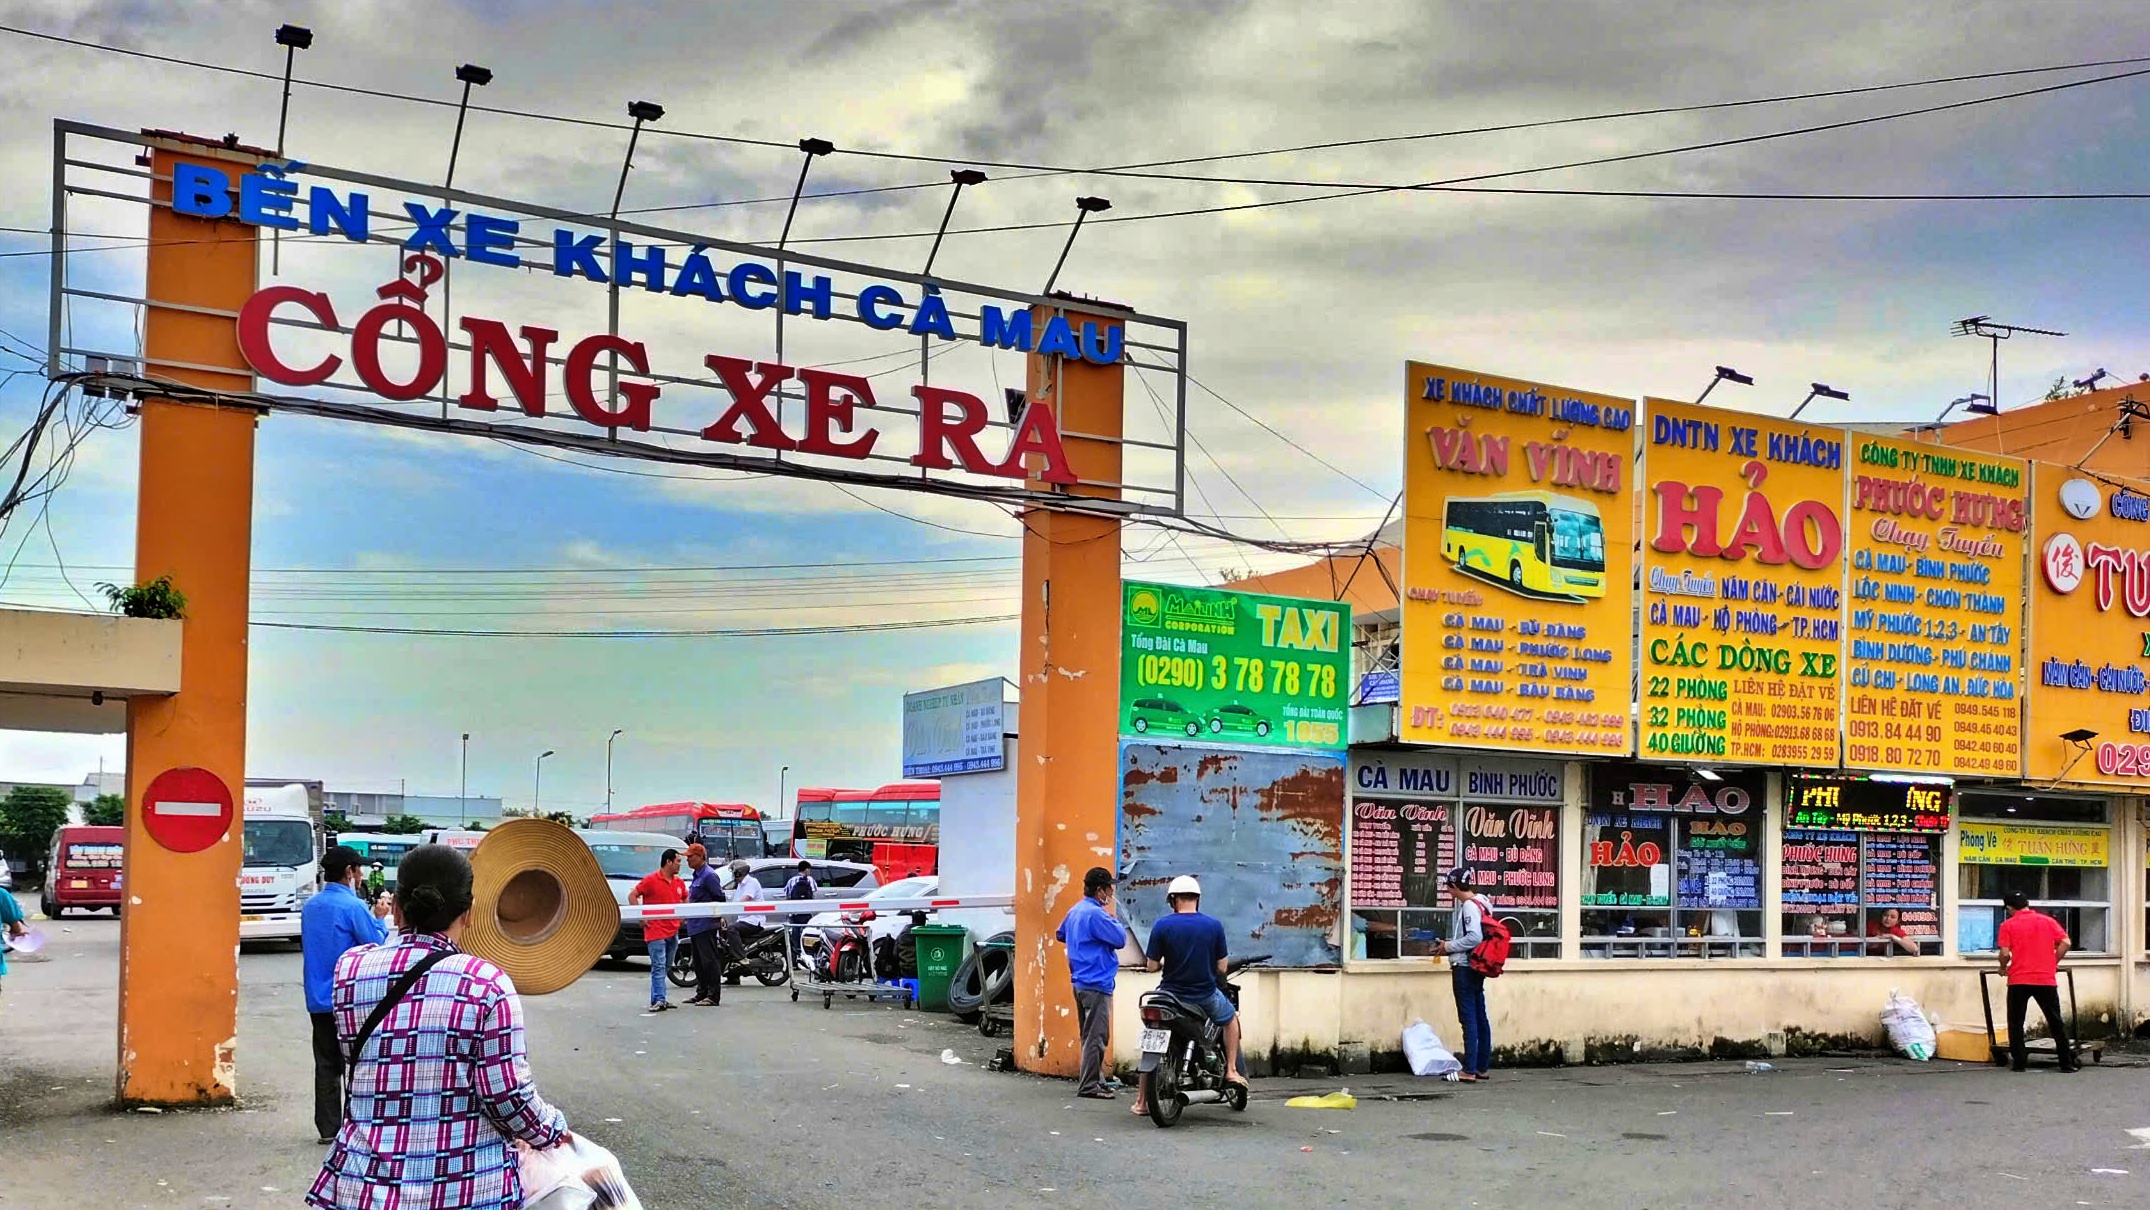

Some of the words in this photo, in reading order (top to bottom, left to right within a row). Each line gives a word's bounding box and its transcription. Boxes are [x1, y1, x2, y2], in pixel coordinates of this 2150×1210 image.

[172, 160, 369, 243] BẾN
[403, 201, 521, 269] XE
[553, 228, 833, 320] KHÁCH
[857, 283, 957, 341] CÀ
[980, 304, 1123, 365] MAU
[236, 253, 662, 433] CỔNG
[701, 354, 881, 462] XE
[910, 385, 1078, 486] RA
[1423, 377, 1445, 400] XE
[1451, 379, 1503, 410] KHÁCH
[1506, 387, 1547, 416] CHẤT
[1550, 397, 1600, 427] LƯỢNG
[1603, 407, 1631, 432] CAO
[1426, 414, 1510, 476] VĂN
[1523, 430, 1623, 494] VĨNH
[1653, 414, 1719, 451] DNTN
[1728, 426, 1759, 457] XE
[1767, 430, 1841, 470] KHÁCH
[1861, 440, 1898, 467] CÔNG
[1902, 451, 1919, 471] TY
[1922, 454, 1957, 477] TNHH
[1959, 461, 1976, 481] XE
[1979, 461, 2019, 487] KHÁCH
[1651, 460, 1842, 569] HẢO
[1854, 475, 1945, 519] PHƯỚC
[1950, 490, 2025, 532] HƯNG
[2112, 488, 2150, 522] CÔNG
[1871, 518, 1930, 553] Chạy
[1937, 526, 2005, 559] Tuyến
[1855, 547, 1873, 570] CÀ
[1876, 553, 1906, 574] MAU
[1915, 556, 1945, 578] BÌNH
[1949, 562, 1990, 585] PHƯỚC
[1720, 576, 1749, 600] NĂM
[1752, 579, 1777, 603] CĂN
[1785, 582, 1805, 606] CÁI
[1808, 585, 1839, 611] NƯỚC
[1854, 576, 1880, 602] LỘC
[1884, 583, 1916, 604] NINH
[1926, 588, 1961, 609] CHƠN
[1964, 592, 2005, 615] THÀNH
[1165, 621, 1235, 636] CORPORATION
[1256, 603, 1340, 653] TAXI
[1650, 599, 1667, 625] CÀ
[1672, 605, 1700, 628] MAU
[1712, 605, 1731, 635] HỘ
[1734, 608, 1777, 635] PHÒNG
[1791, 616, 1839, 641] TP.HCM
[1854, 608, 1874, 631] MỸ
[1877, 612, 1922, 635] PHƯỚC
[1969, 623, 1986, 643] AN
[1988, 623, 2010, 645] TÂY
[1131, 633, 1153, 651] Tổng
[1156, 635, 1171, 652] Đài
[1174, 638, 1185, 653] Cà
[1188, 640, 1208, 655] Mau
[1442, 634, 1465, 651] CÀ
[1468, 637, 1504, 653] MAU
[1517, 640, 1570, 659] PHƯỚC
[1572, 644, 1612, 663] LONG
[1650, 633, 1708, 667] CÁC
[1717, 638, 1792, 675] DÒNG
[1799, 652, 1836, 679] XE
[1853, 636, 1884, 660] BÌNH
[1887, 641, 1933, 665] DƯƠNG
[1941, 646, 1966, 669] PHÚ
[1970, 650, 2012, 673] CHÁNH
[1137, 654, 1204, 691] (0290)
[1211, 655, 1227, 690] 3
[1233, 657, 1264, 693] 78
[1270, 660, 1300, 696] 78
[1306, 663, 1336, 698] 78
[1442, 656, 1465, 671] CÀ
[1468, 658, 1504, 674] MAU
[1517, 662, 1548, 679] TRÀ
[1553, 665, 1588, 681] VINH
[2042, 656, 2069, 686] NĂM
[2070, 658, 2092, 689] CĂN
[2100, 659, 2117, 692] CÁI
[2118, 663, 2146, 695] NƯỚC
[1648, 676, 1670, 698] 22
[1675, 675, 1728, 701] PHÒNG
[1733, 678, 1764, 695] LIÊN
[1767, 678, 1785, 701] HỆ
[1788, 680, 1815, 702] ĐẶT
[1818, 682, 1836, 701] VÉ
[1327, 706, 1343, 721] QUỐC
[1411, 705, 1445, 730] ĐT:
[1648, 706, 1669, 728] 32
[1675, 705, 1727, 730] PHÒNG
[1732, 702, 1743, 717] CÀ
[1745, 703, 1766, 719] MAU:
[1771, 704, 1811, 720] 02903.56
[1812, 707, 1822, 721] 76
[1824, 708, 1835, 722] 06
[1850, 694, 1877, 716] LIÊN
[1881, 696, 1897, 720] HỆ
[1900, 698, 1923, 721] ĐẶT
[1927, 700, 1942, 720] VÉ
[1955, 702, 2000, 717] 0949.545
[2003, 706, 2016, 719] 118
[1284, 720, 1340, 744] 1055
[1648, 732, 1670, 753] 40
[1671, 729, 1726, 755] GIƯỜNG
[1905, 724, 1922, 742] 44
[1926, 726, 1942, 743] 90
[1731, 742, 1765, 758] TP.HCM:
[1772, 743, 1808, 759] 0283955
[1811, 745, 1822, 760] 29
[1823, 747, 1835, 761] 59
[1907, 748, 1922, 766] 72
[1926, 749, 1941, 767] 70
[1357, 760, 1389, 790] CÀ
[1399, 767, 1450, 793] MAU
[1468, 766, 1503, 796] BÌNH
[1508, 769, 1557, 798] PHƯỚC
[1465, 807, 1507, 839] Văn
[1508, 808, 1555, 840] Vĩnh
[1465, 842, 1478, 862] CÀ
[1479, 846, 1499, 862] MAU
[1506, 843, 1519, 863] BÙ
[1520, 846, 1543, 863] ĐĂNG
[1589, 831, 1660, 867] HẢO
